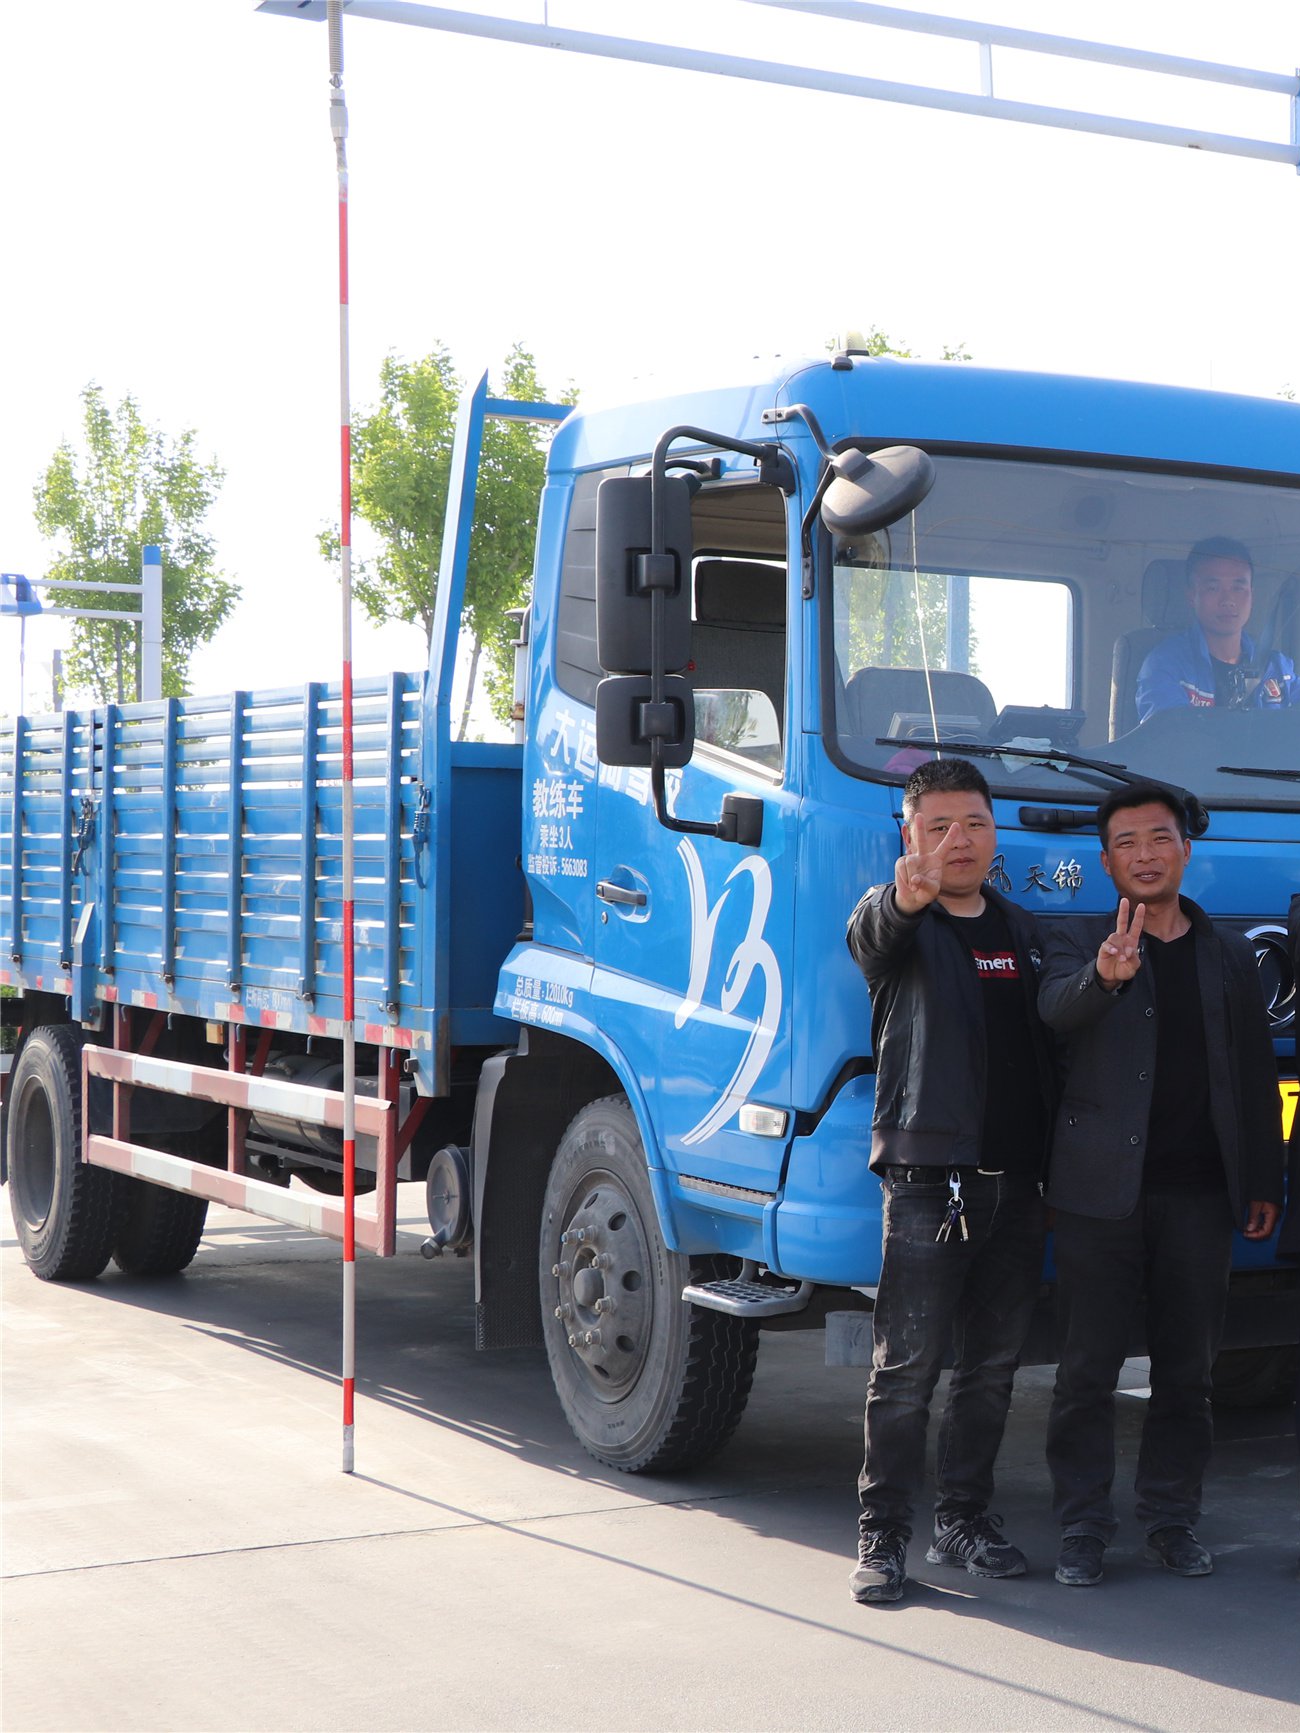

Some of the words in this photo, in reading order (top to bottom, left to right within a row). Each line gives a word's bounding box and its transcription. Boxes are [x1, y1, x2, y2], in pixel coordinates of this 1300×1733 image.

[532, 778, 584, 820] 教练车
[539, 824, 574, 850] 乘坐3人
